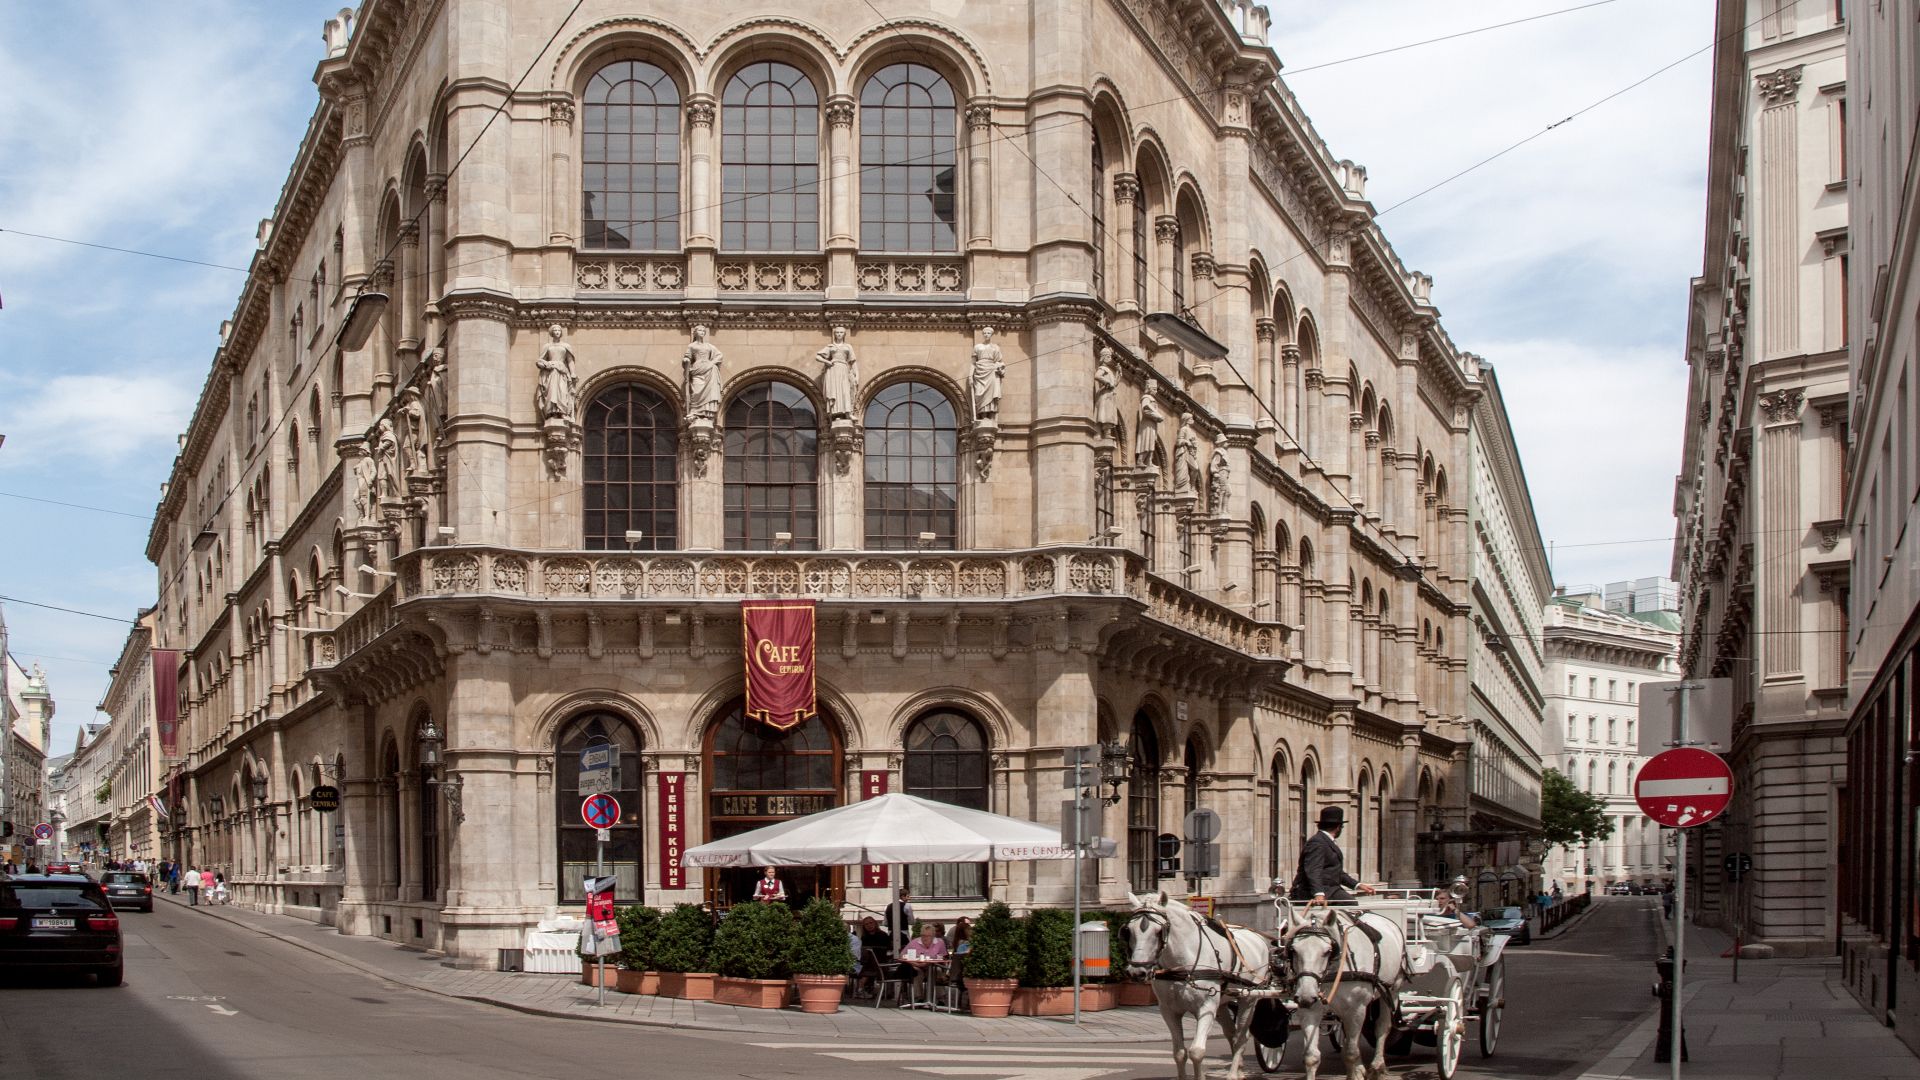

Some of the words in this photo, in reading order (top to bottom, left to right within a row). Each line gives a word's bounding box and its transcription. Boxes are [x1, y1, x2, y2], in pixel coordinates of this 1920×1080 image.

[755, 639, 801, 676] CAFE
[666, 775, 678, 831] WIENER
[723, 796, 757, 814] CAFE
[767, 796, 827, 814] CENTRAL
[668, 837, 678, 886] KÜCHE
[689, 855, 706, 863] CAFE
[708, 854, 742, 863] CENTRAL
[1002, 848, 1028, 857] CAFE
